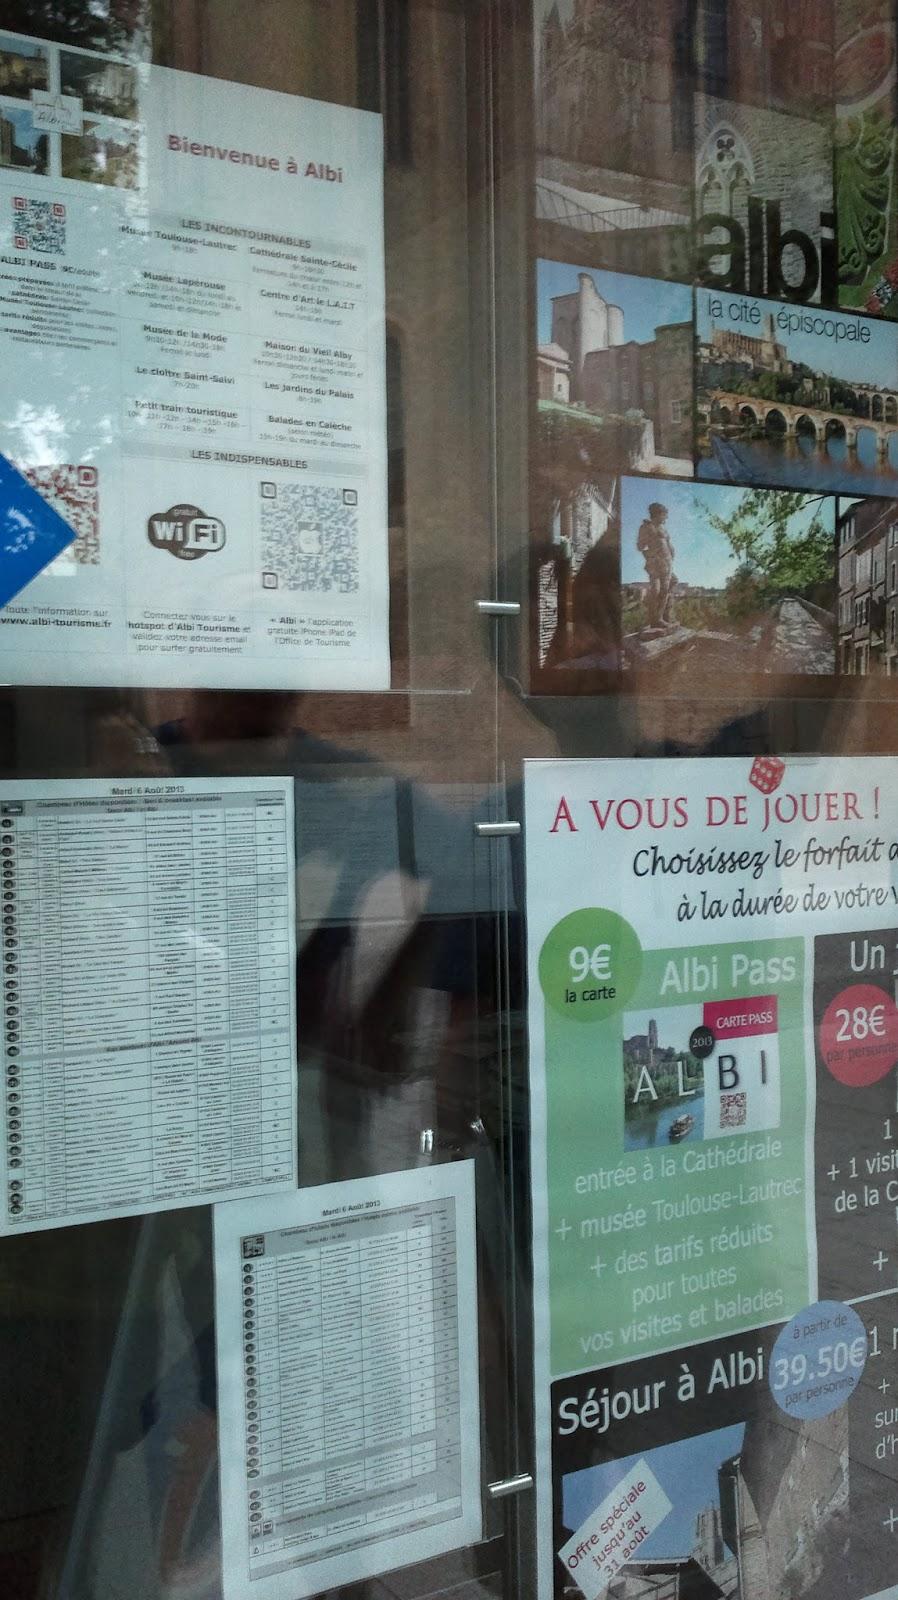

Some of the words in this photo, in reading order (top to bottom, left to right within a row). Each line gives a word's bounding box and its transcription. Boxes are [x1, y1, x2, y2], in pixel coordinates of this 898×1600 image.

[167, 134, 280, 172] Bienvenue
[286, 156, 299, 175] à
[304, 161, 344, 183] Albi
[181, 219, 202, 231] LES
[205, 223, 312, 249] INCONTOURNABLES
[691, 195, 838, 309] albi
[260, 288, 290, 301] Centre
[708, 294, 723, 319] la
[728, 299, 762, 325] cité
[777, 305, 871, 343] épiscopale
[176, 328, 189, 338] de
[191, 330, 200, 339] la
[202, 332, 229, 343] Mode
[264, 341, 296, 352] Maison
[299, 345, 310, 353] du
[135, 366, 148, 375] Le
[264, 382, 279, 391] Les
[315, 388, 326, 397] du
[329, 389, 355, 400] Palais
[160, 403, 183, 413] train
[186, 406, 239, 420] touristique
[267, 415, 303, 427] Balades
[305, 420, 317, 428] en
[191, 449, 212, 460] LES
[214, 451, 309, 469] INDISPENSABLES
[0, 617, 112, 629] www.albi-tourisme.fr
[128, 620, 165, 632] hotspot
[168, 622, 195, 631] d'Albi
[197, 623, 240, 633] Tourisme
[548, 794, 579, 834] A
[589, 796, 690, 832] VOUS
[705, 795, 748, 827] DE
[760, 791, 865, 832] JOUER
[872, 785, 881, 820] !
[633, 844, 772, 880] Choisissez
[774, 840, 801, 868] le
[803, 836, 885, 873] forfait
[677, 896, 698, 923] à
[701, 890, 728, 922] la
[732, 887, 800, 918] durée
[802, 883, 832, 913] de
[833, 882, 888, 910] votre
[568, 943, 612, 983] 9€
[850, 939, 886, 972] Un
[658, 955, 719, 996] Albi
[731, 952, 797, 989] Pass
[565, 988, 577, 1003] la
[582, 985, 617, 1002] carte
[716, 1014, 747, 1029] CARTE
[748, 1011, 774, 1025] PASS
[835, 1004, 887, 1042] 28€
[691, 1036, 713, 1049] 2013
[883, 1118, 893, 1140] 1
[575, 1160, 637, 1195] entrée
[642, 1156, 655, 1182] à
[660, 1154, 677, 1178] la
[682, 1136, 783, 1174] Cathédrale
[849, 1156, 859, 1179] 1
[580, 1203, 648, 1238] musée
[652, 1176, 804, 1223] Toulouse-Lautrec
[834, 1190, 858, 1214] de
[864, 1185, 880, 1207] la
[614, 1249, 649, 1275] des
[654, 1234, 704, 1267] tarifs
[710, 1222, 774, 1253] réduits
[632, 1279, 675, 1312] pour
[681, 1265, 738, 1295] toutes
[580, 1328, 614, 1355] vos
[619, 1313, 683, 1345] visites
[688, 1303, 708, 1327] et
[715, 1287, 784, 1322] balades
[803, 1318, 831, 1337] partir
[834, 1313, 848, 1328] de
[869, 1325, 881, 1356] 1
[774, 1336, 867, 1391] 39.50€
[557, 1378, 667, 1436] Séjour
[677, 1362, 696, 1403] à
[706, 1346, 766, 1394] Albi
[785, 1391, 802, 1408] par
[567, 1534, 600, 1569] Offre
[600, 1480, 647, 1535] spéciale
[592, 1511, 643, 1572] jusqu'au
[603, 1559, 621, 1579] 31
[622, 1525, 651, 1559] août
